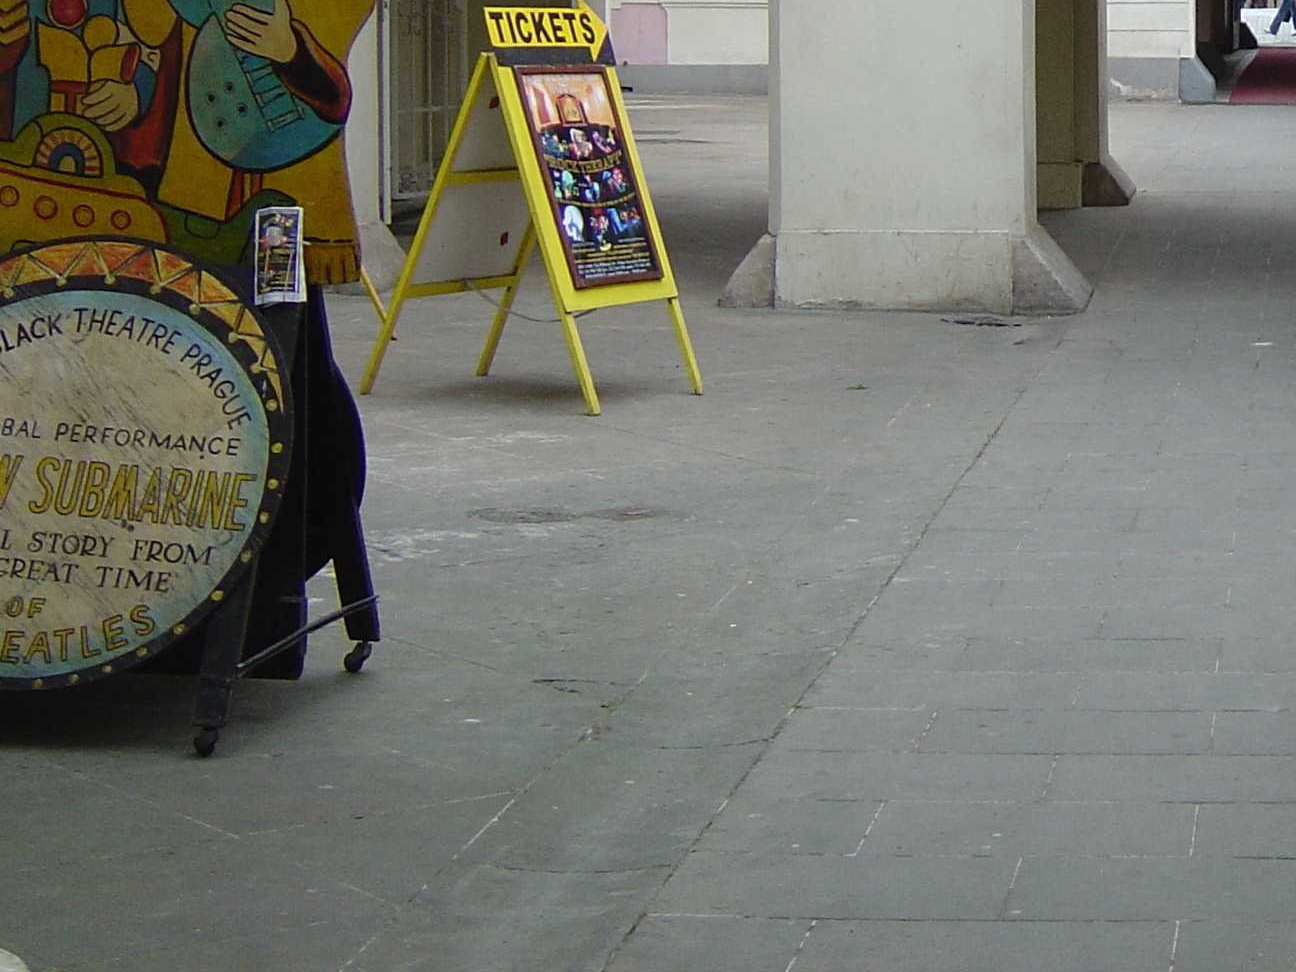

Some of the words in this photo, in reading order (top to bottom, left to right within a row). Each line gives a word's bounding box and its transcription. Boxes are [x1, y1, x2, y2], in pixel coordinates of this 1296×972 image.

[487, 11, 597, 45] TICKETS
[0, 313, 63, 354] LACK
[73, 308, 183, 355] THEATRE
[179, 343, 252, 430] PRAGUE
[54, 422, 242, 457] PERFORMANCE
[28, 456, 258, 532] SUBMARINE
[27, 530, 115, 559] STORY
[129, 538, 214, 566] FROM
[96, 565, 172, 593] TIME
[6, 595, 47, 619] OF
[0, 604, 156, 665] EATLES
